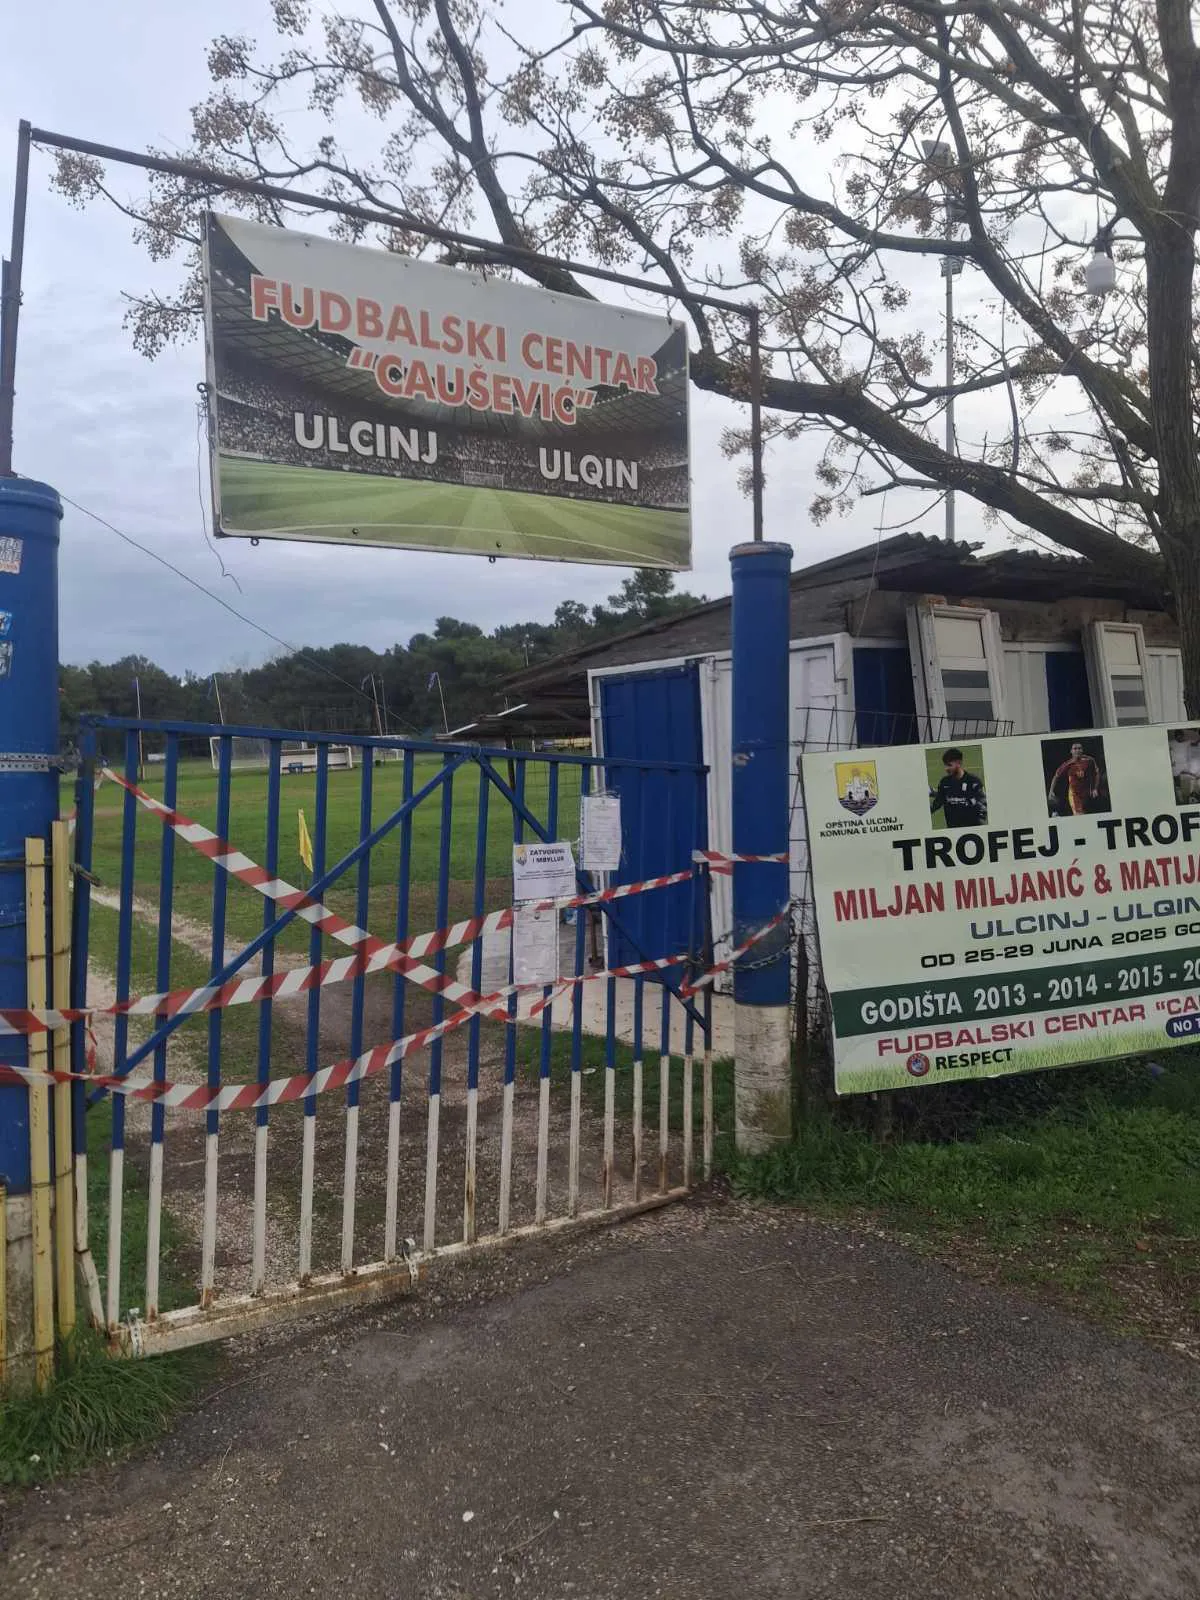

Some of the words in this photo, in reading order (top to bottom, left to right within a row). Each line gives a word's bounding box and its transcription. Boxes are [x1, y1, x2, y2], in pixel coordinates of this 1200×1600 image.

[251, 275, 507, 363] FUDBALSKI
[521, 332, 659, 395] CENTAR
[294, 412, 438, 464] ULCINJ
[539, 448, 639, 490] ULQIN
[820, 828, 861, 838] KOMUNA
[866, 816, 898, 826] ULCINJ
[893, 826, 1059, 871] TROFEJ
[1074, 838, 1086, 846] -
[1097, 811, 1200, 850] TROF
[834, 881, 945, 922] MILJAN
[955, 858, 1085, 910] MILJANIĆ
[1094, 864, 1113, 894] &
[1120, 854, 1200, 891] MATIJ
[921, 953, 955, 968] OD
[964, 944, 1034, 964] 25-29
[1042, 936, 1104, 954] JUNA
[1111, 927, 1167, 945] 2025
[971, 909, 1089, 939] ULCINJ
[861, 990, 963, 1025] GODIŠTA
[974, 984, 1026, 1011] 2013
[1048, 974, 1098, 1001] 2014
[1118, 964, 1163, 992] 2015
[878, 1020, 1034, 1056] FUDBALSKI
[1044, 1004, 1146, 1034] CENTAR
[1155, 994, 1200, 1015] “CA
[1172, 1019, 1193, 1034] NO
[935, 1048, 1013, 1070] RESPECT
